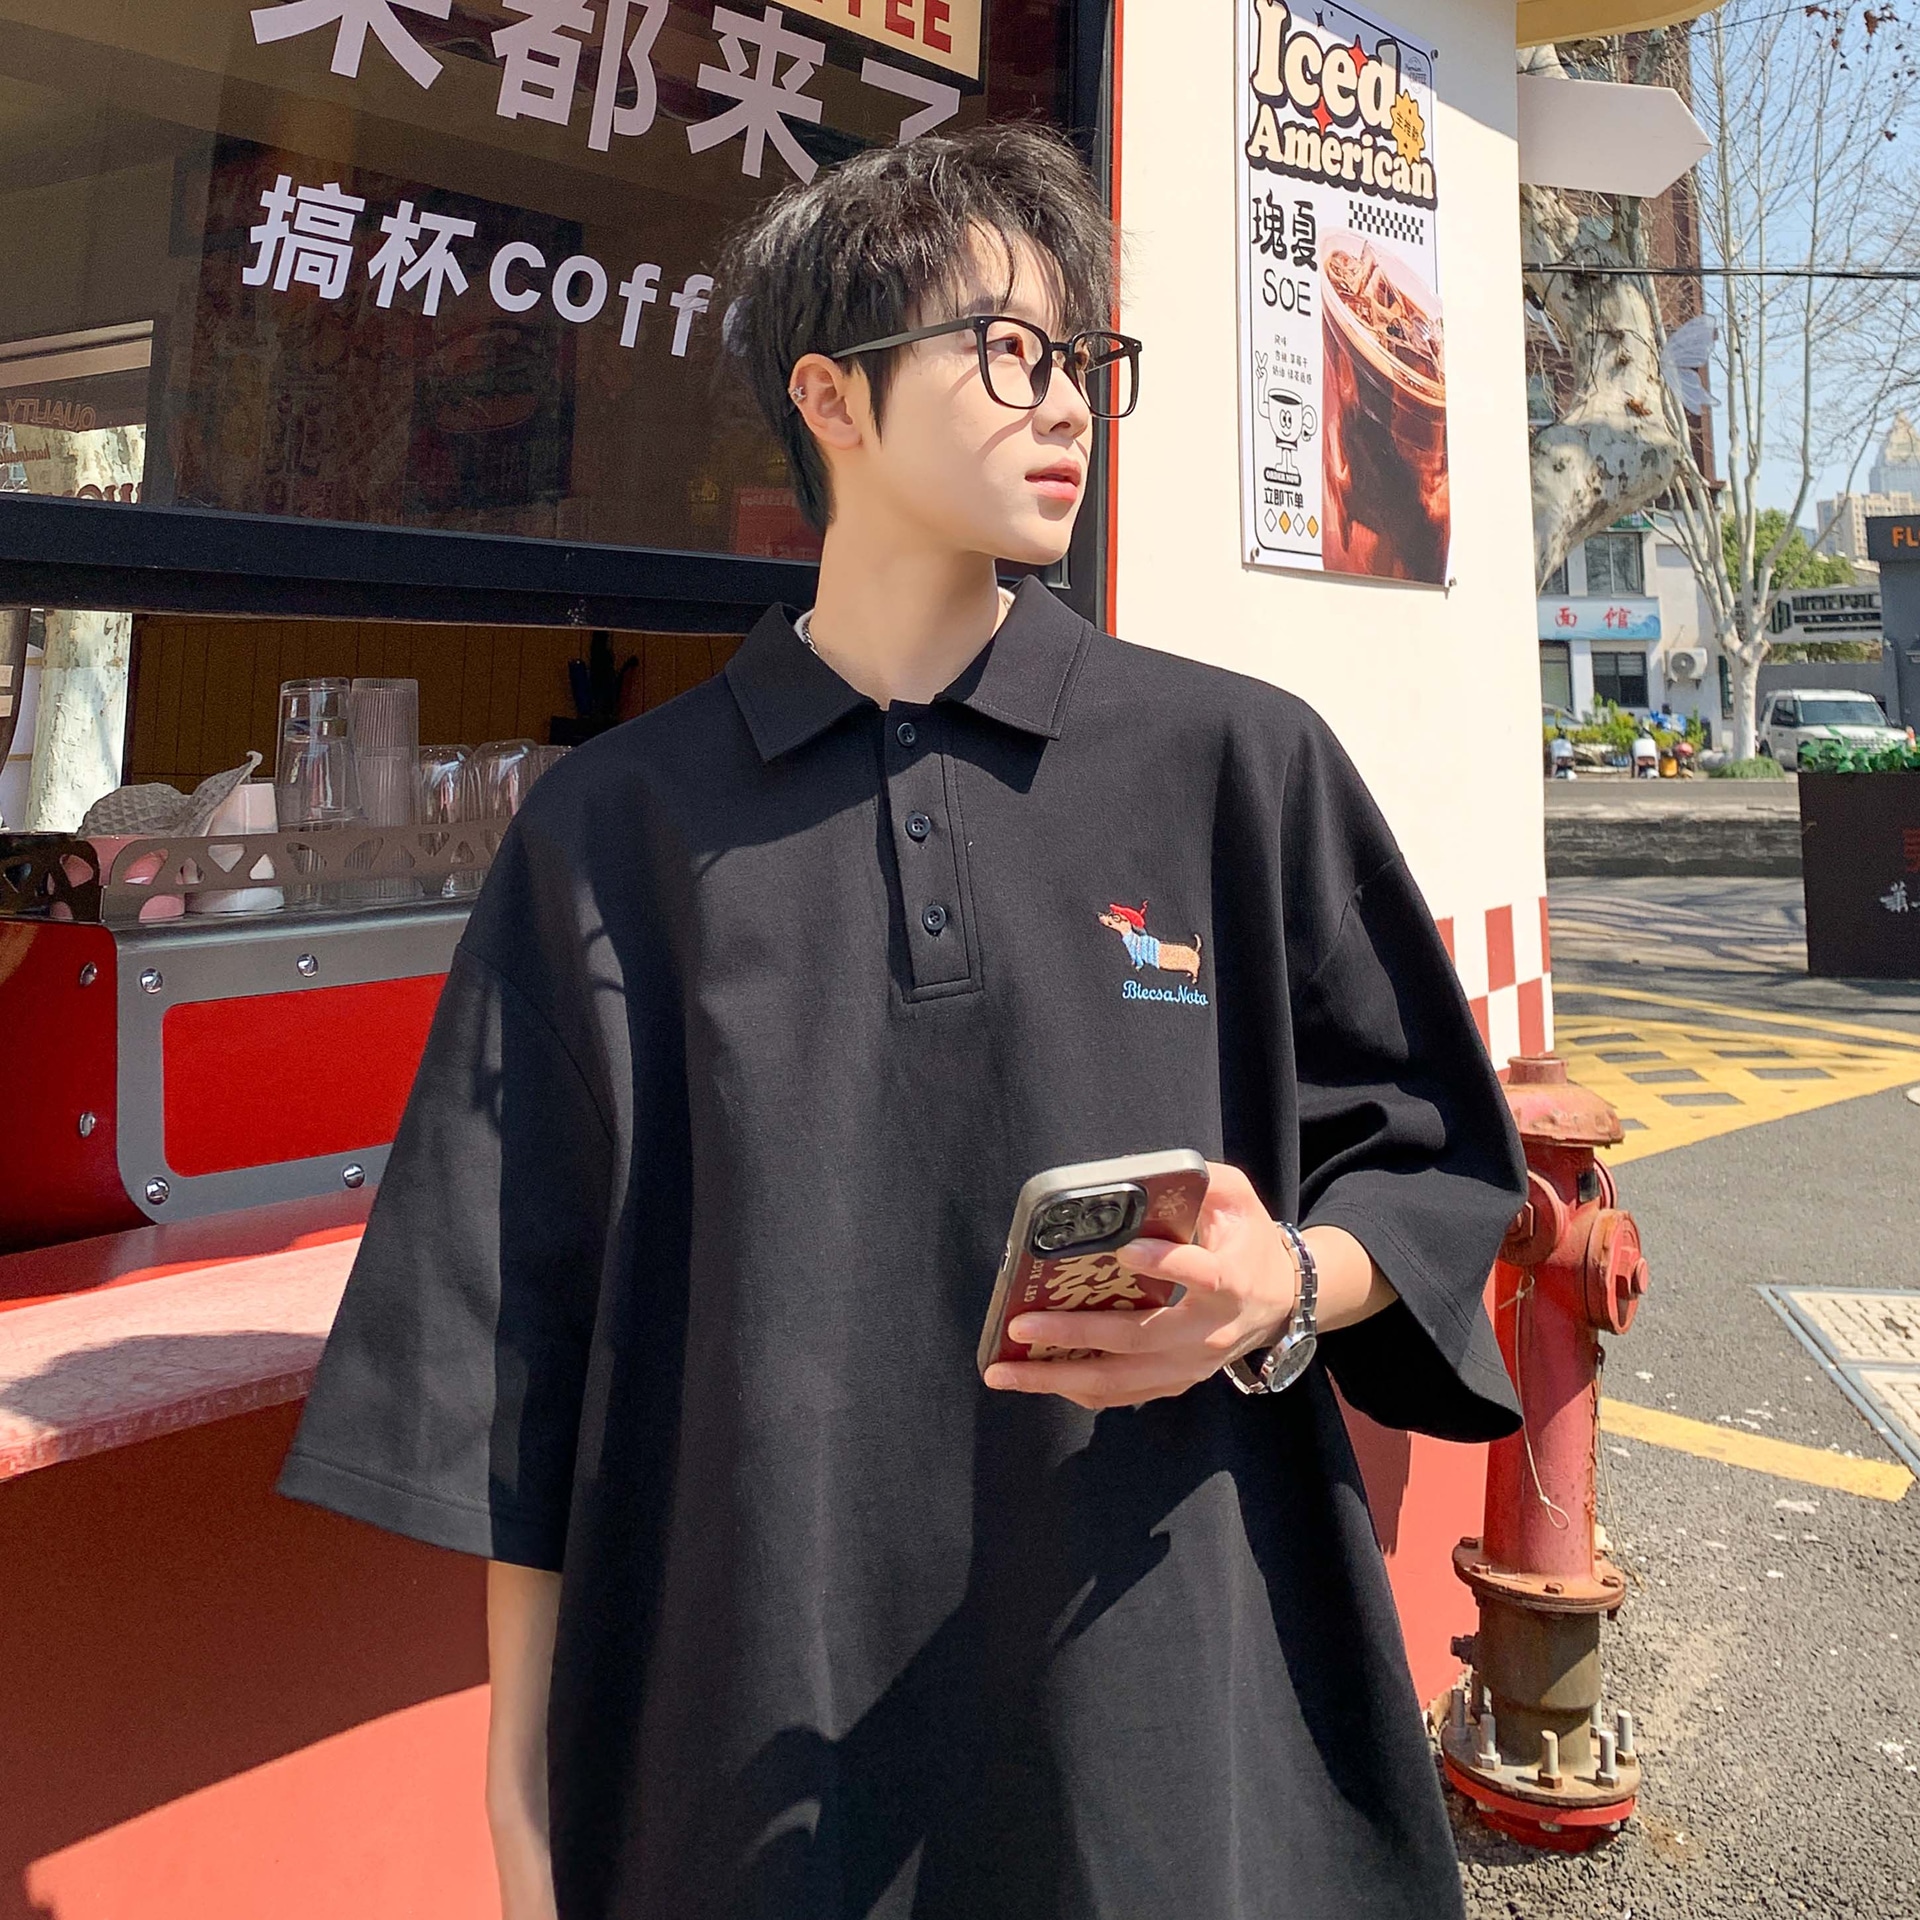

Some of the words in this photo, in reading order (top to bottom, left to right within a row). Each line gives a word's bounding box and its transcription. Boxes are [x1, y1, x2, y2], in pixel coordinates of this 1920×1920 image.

[1250, 0, 1399, 140] Iced
[1246, 102, 1437, 206] American
[1251, 188, 1318, 271] 瑰夏
[1262, 268, 1311, 317] SOE
[1263, 487, 1304, 509] 立即下单
[1892, 526, 1920, 548] FL
[1554, 606, 1632, 629] 面馆
